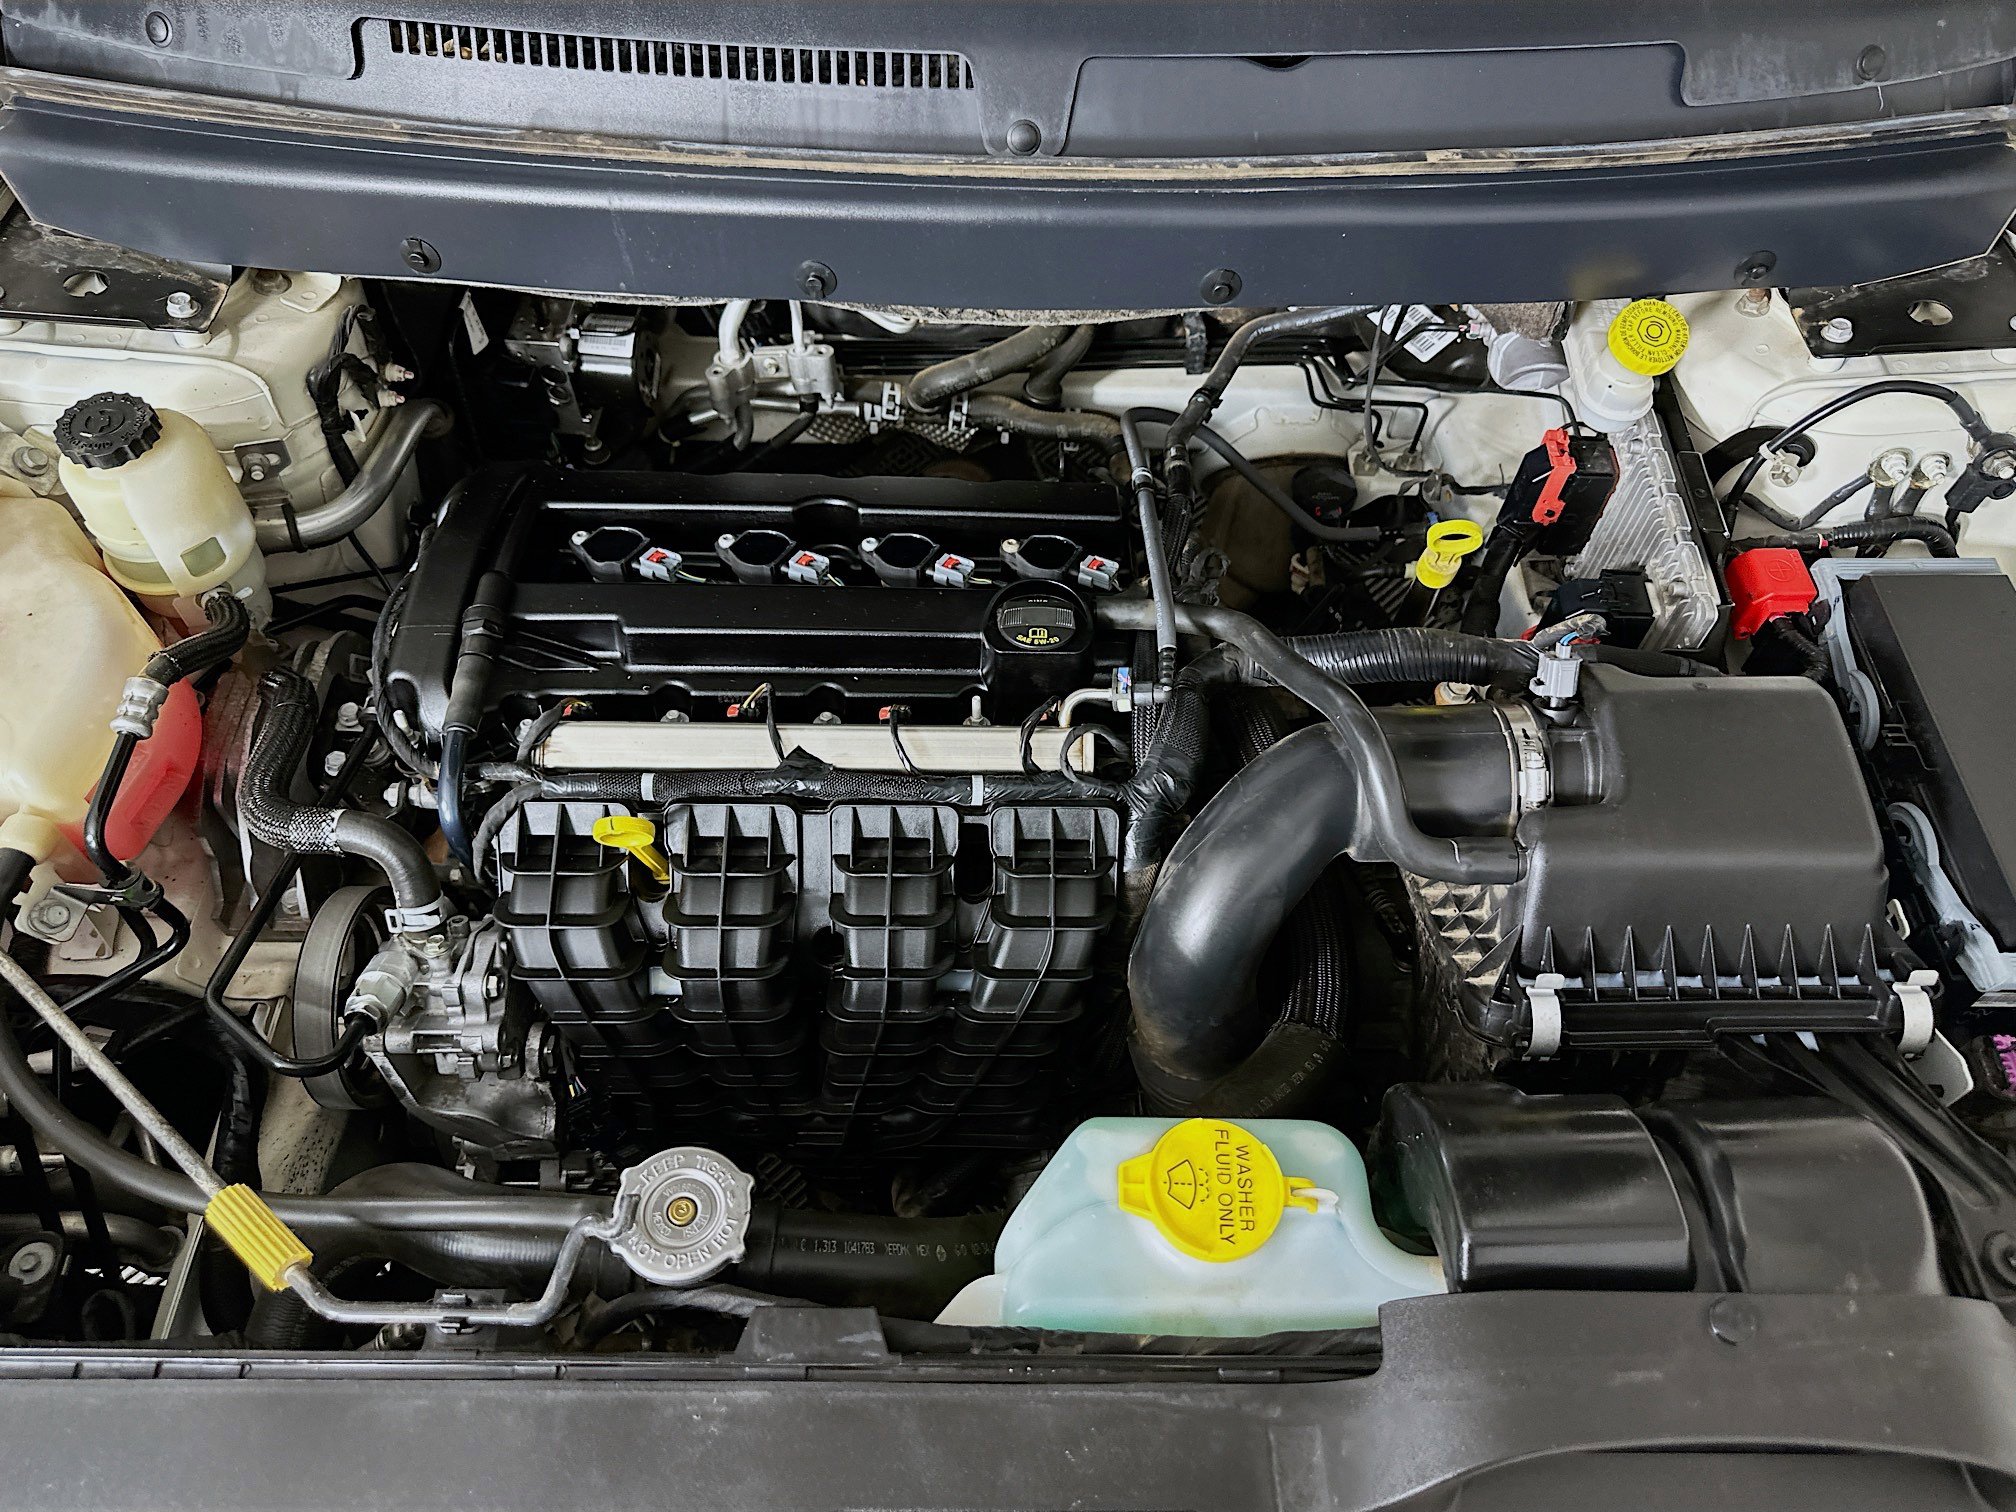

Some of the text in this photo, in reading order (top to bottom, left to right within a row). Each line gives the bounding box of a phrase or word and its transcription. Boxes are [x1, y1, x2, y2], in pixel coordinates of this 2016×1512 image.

[1632, 307, 1653, 320] BEFORE
[1655, 308, 1678, 327] REMOVING
[1627, 319, 1635, 331] CAP
[1628, 334, 1646, 353] FILLER
[1649, 354, 1674, 363] NETTOYER
[1016, 634, 1033, 645] SAE
[640, 1154, 737, 1187] KEEP TIGHT
[1214, 1129, 1236, 1246] FLUID ONLY
[1235, 1144, 1256, 1232] WASHER
[628, 1234, 662, 1264] NOT
[663, 1244, 712, 1270] OPEN
[711, 1217, 739, 1251] HOT
